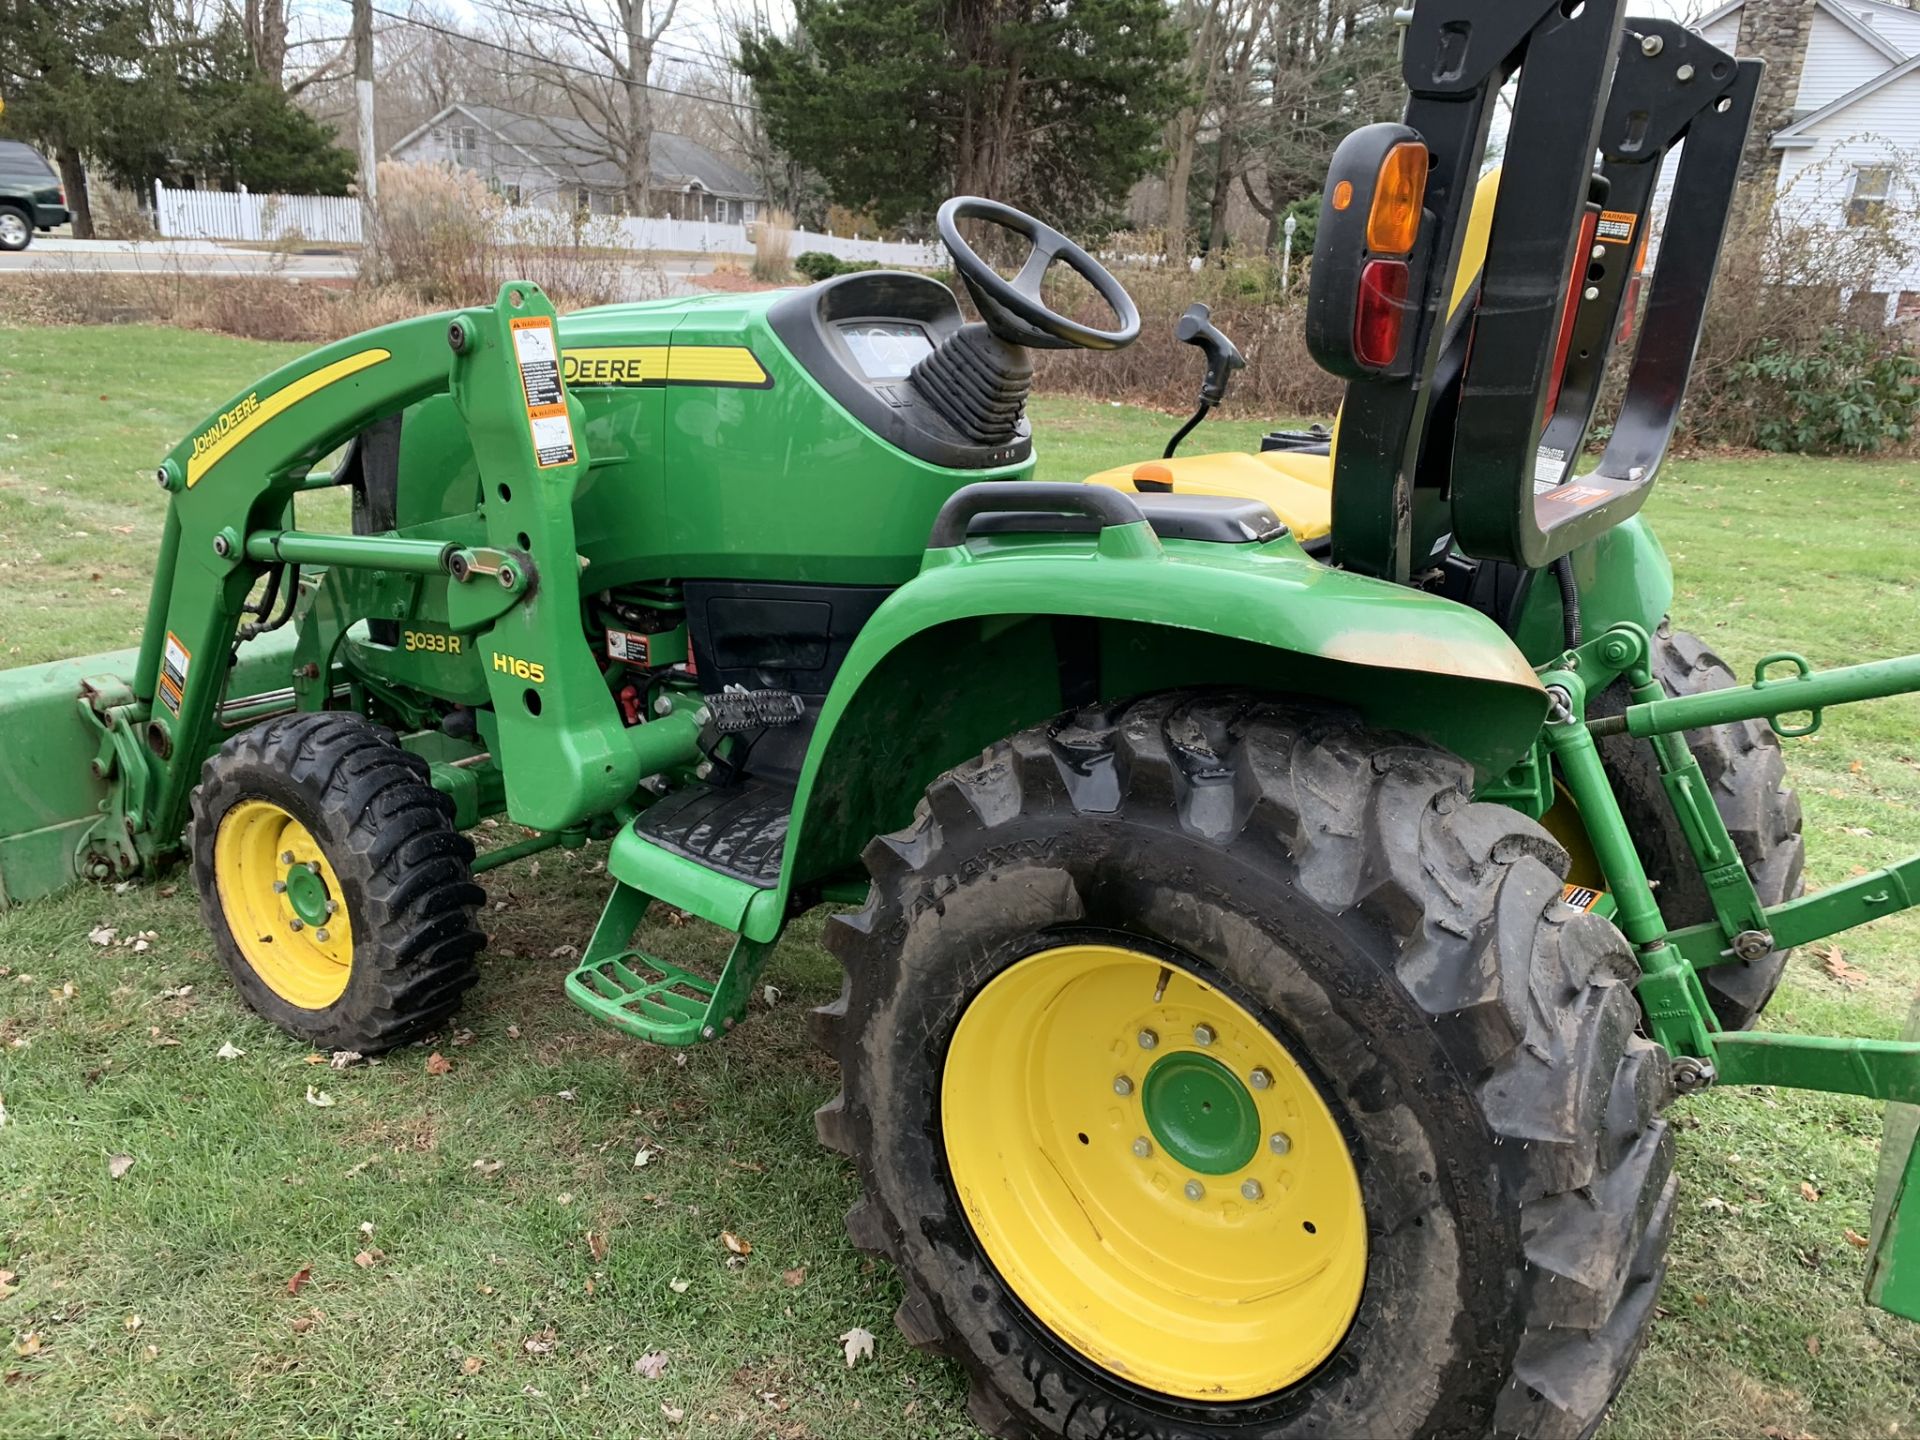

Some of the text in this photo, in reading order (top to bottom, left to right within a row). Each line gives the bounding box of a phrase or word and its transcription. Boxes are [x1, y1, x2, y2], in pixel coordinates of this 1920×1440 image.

[563, 356, 641, 379] DEERE
[192, 391, 260, 460] JOHN DEERE
[493, 651, 545, 684] H165
